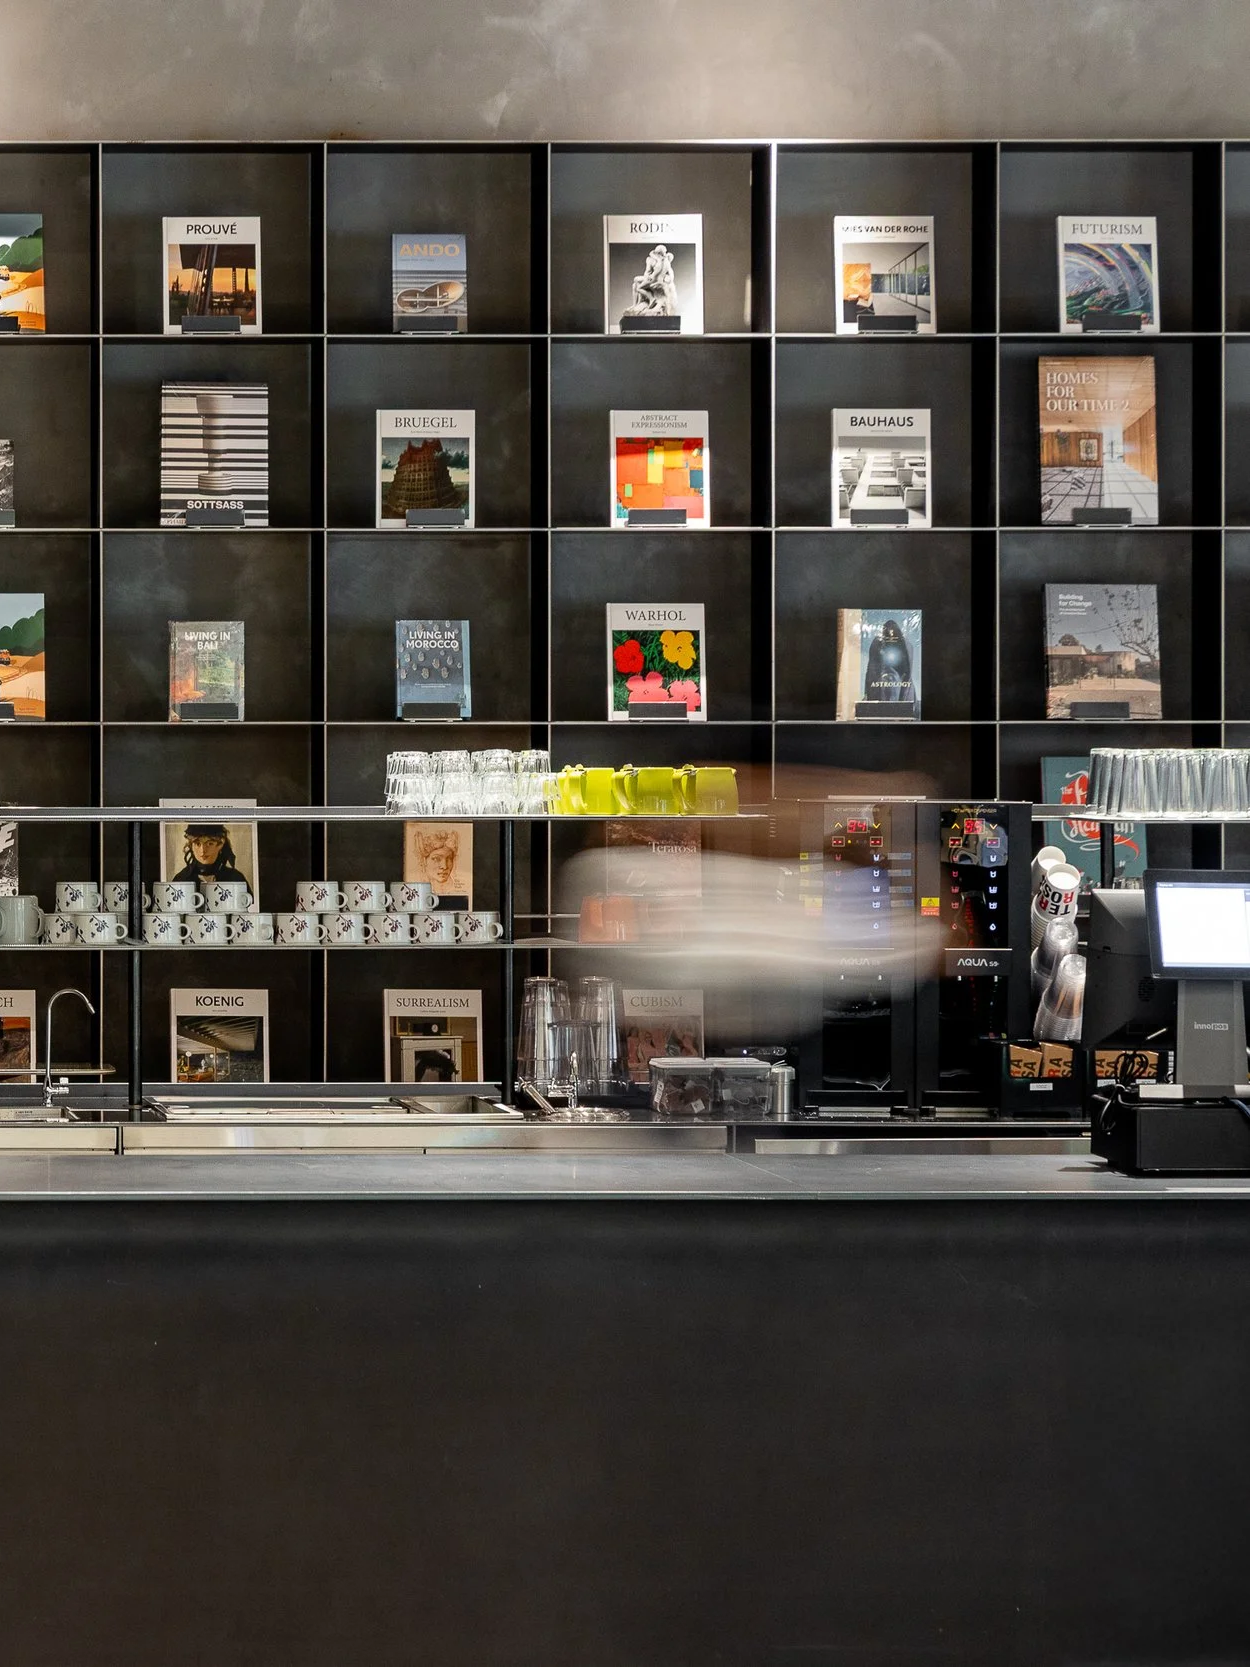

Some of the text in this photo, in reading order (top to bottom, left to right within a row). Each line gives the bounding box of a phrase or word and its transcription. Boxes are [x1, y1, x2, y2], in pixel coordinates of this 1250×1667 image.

[186, 222, 237, 234] PROUVÉ
[864, 225, 882, 233] VAN
[884, 225, 902, 233] DER
[903, 225, 929, 233] ROHE
[1072, 223, 1143, 234] FUTURISM
[399, 243, 461, 257] ANDO
[1046, 372, 1099, 384] HOMES
[1046, 386, 1075, 398] FOR
[1046, 399, 1130, 412] OUR TIME 2
[394, 416, 457, 428] BRUEGEL
[850, 416, 915, 427] BAUHAUS
[187, 500, 244, 509] SOTTSASS
[625, 610, 686, 621] WARHOL
[184, 631, 231, 641] LIVING IN
[409, 631, 455, 640] LIVING IN
[197, 641, 219, 650] BALI
[406, 640, 459, 649] MOROCCO
[649, 841, 697, 853] Terarosa
[957, 958, 988, 967] AQUA
[195, 996, 244, 1007] KOENIG
[396, 998, 469, 1008] SURREALISM
[630, 996, 684, 1007] CUBISM
